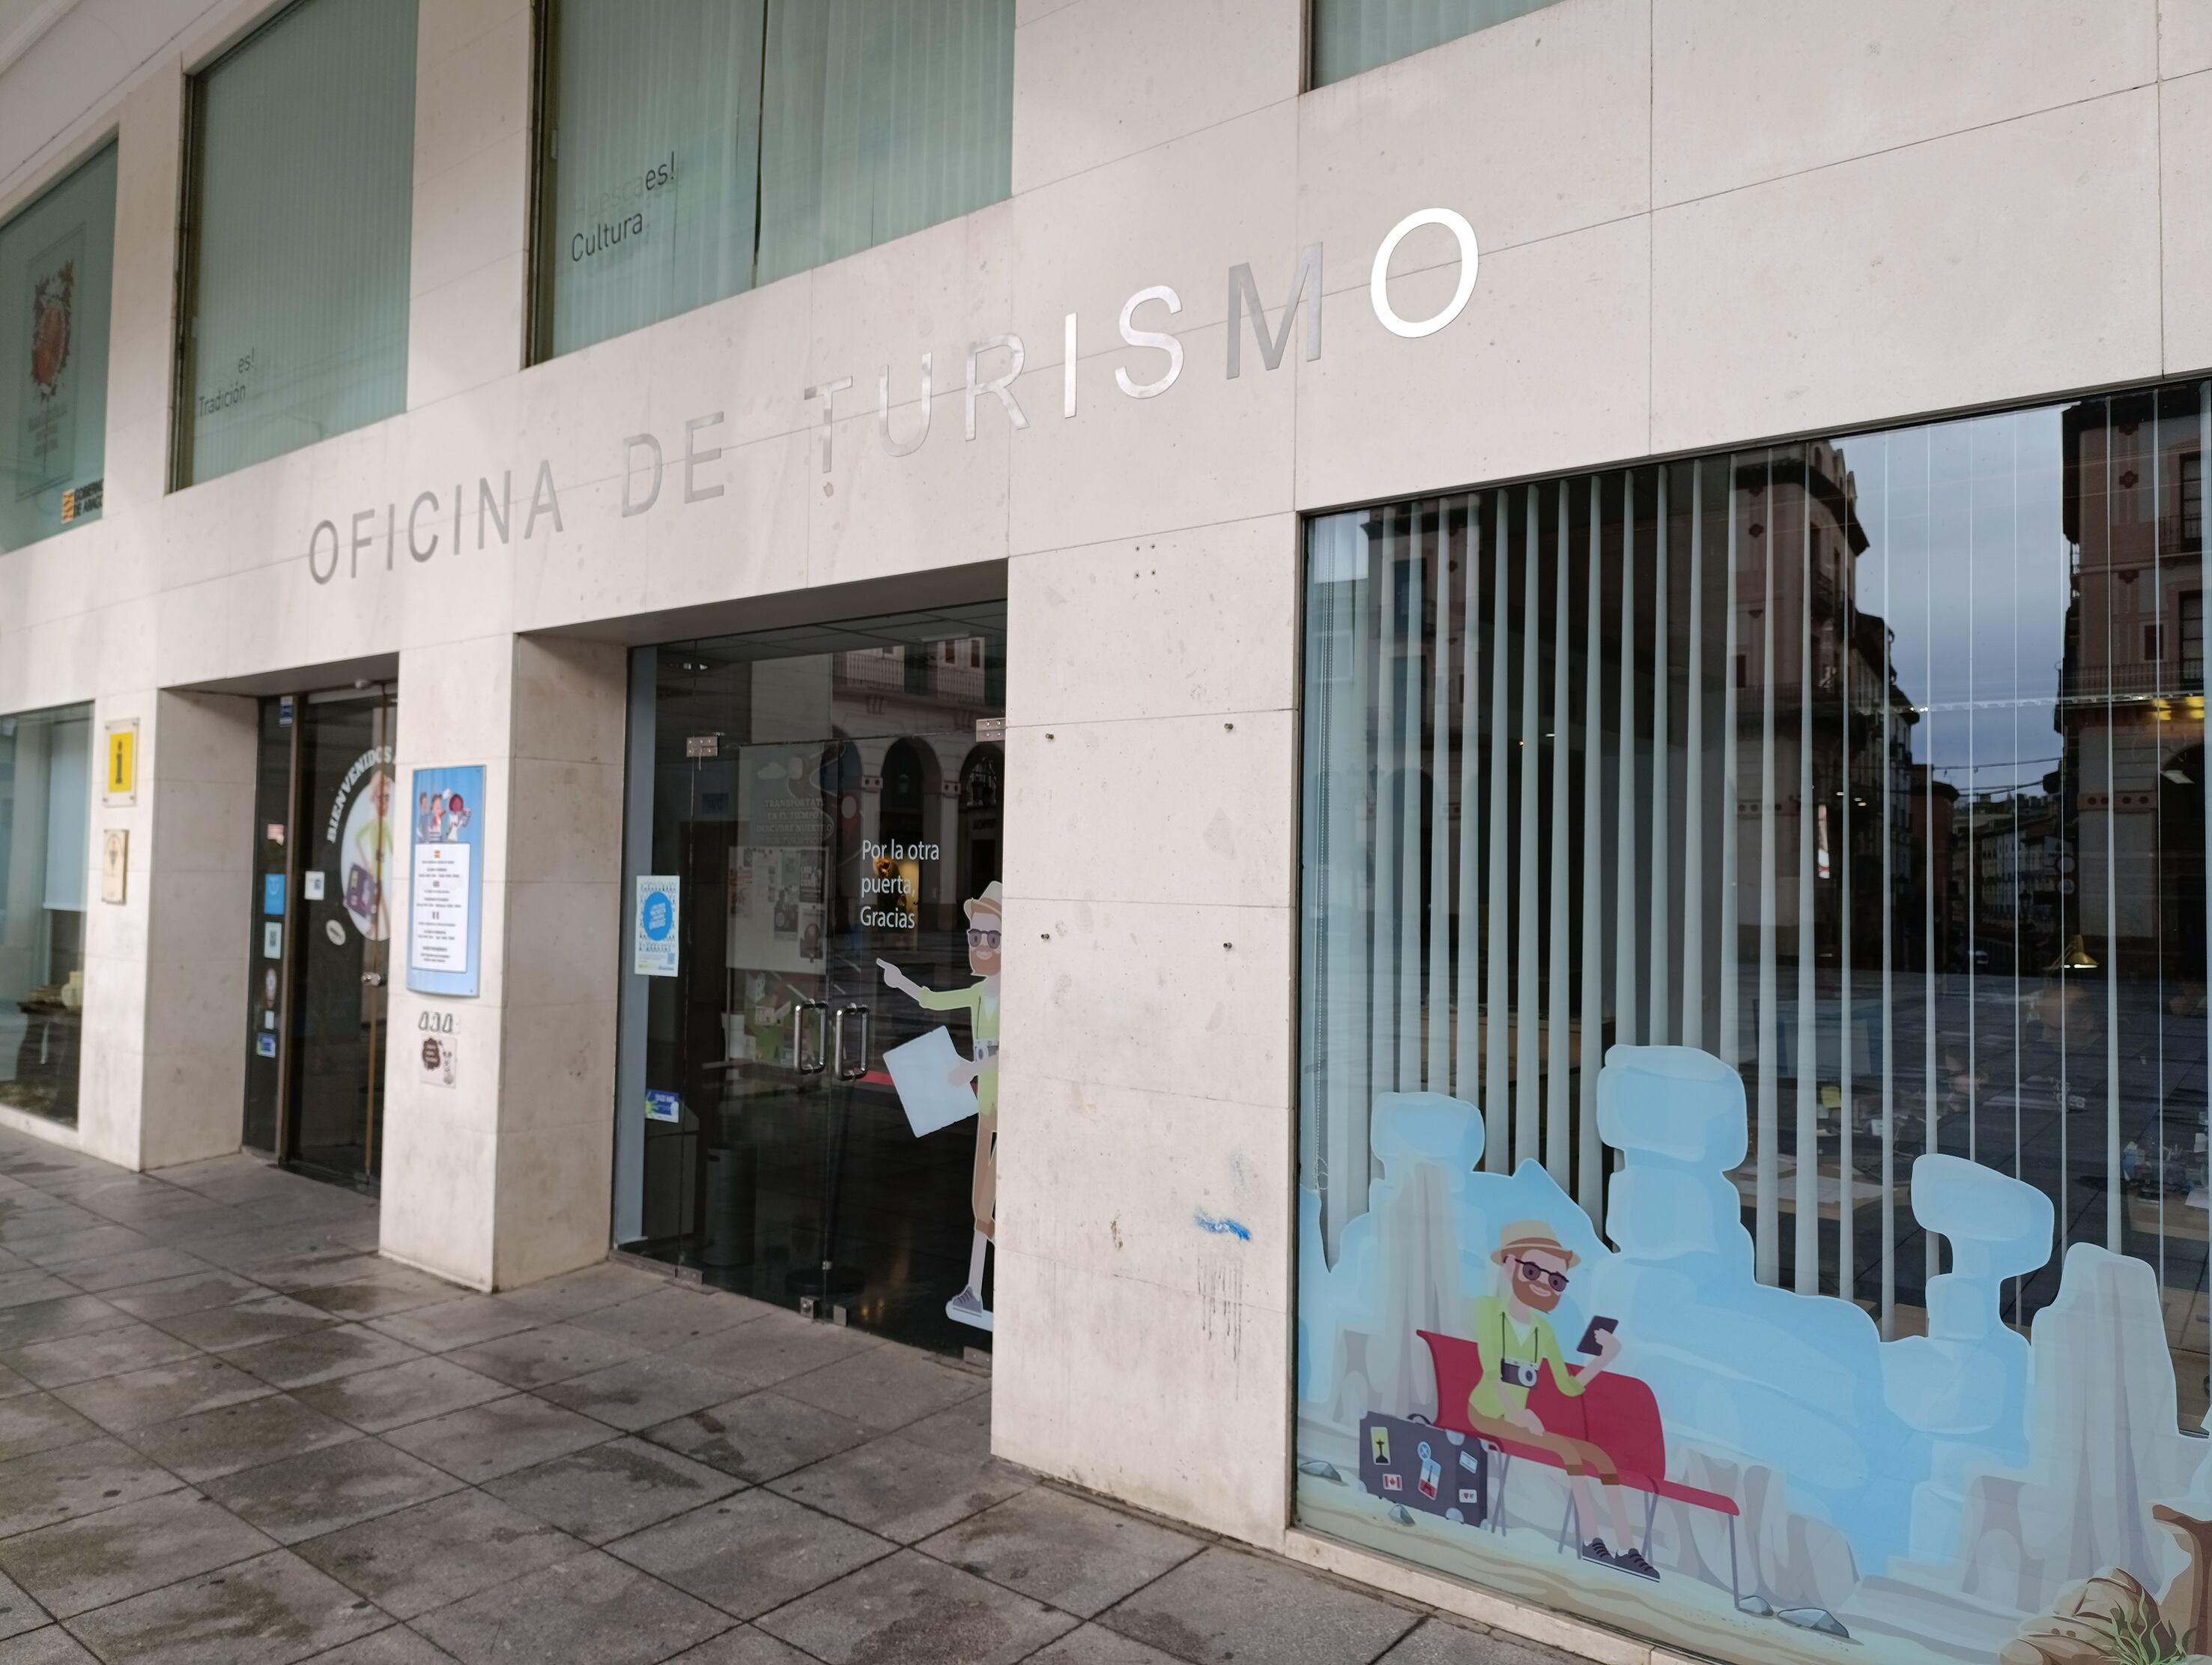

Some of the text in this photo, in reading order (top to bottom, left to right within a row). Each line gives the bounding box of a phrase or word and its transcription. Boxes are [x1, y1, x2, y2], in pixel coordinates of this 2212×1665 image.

[645, 151, 675, 192] es!
[571, 213, 643, 263] Cultura
[199, 381, 246, 417] Tradición
[308, 207, 1479, 586] OFICINA DE TURISMO
[74, 479, 103, 501] GOBIERN
[327, 745, 393, 844] BIENVENIDOS
[862, 838, 939, 861] Por la otra
[861, 875, 916, 899] puerta,
[860, 906, 915, 929] Gracias
